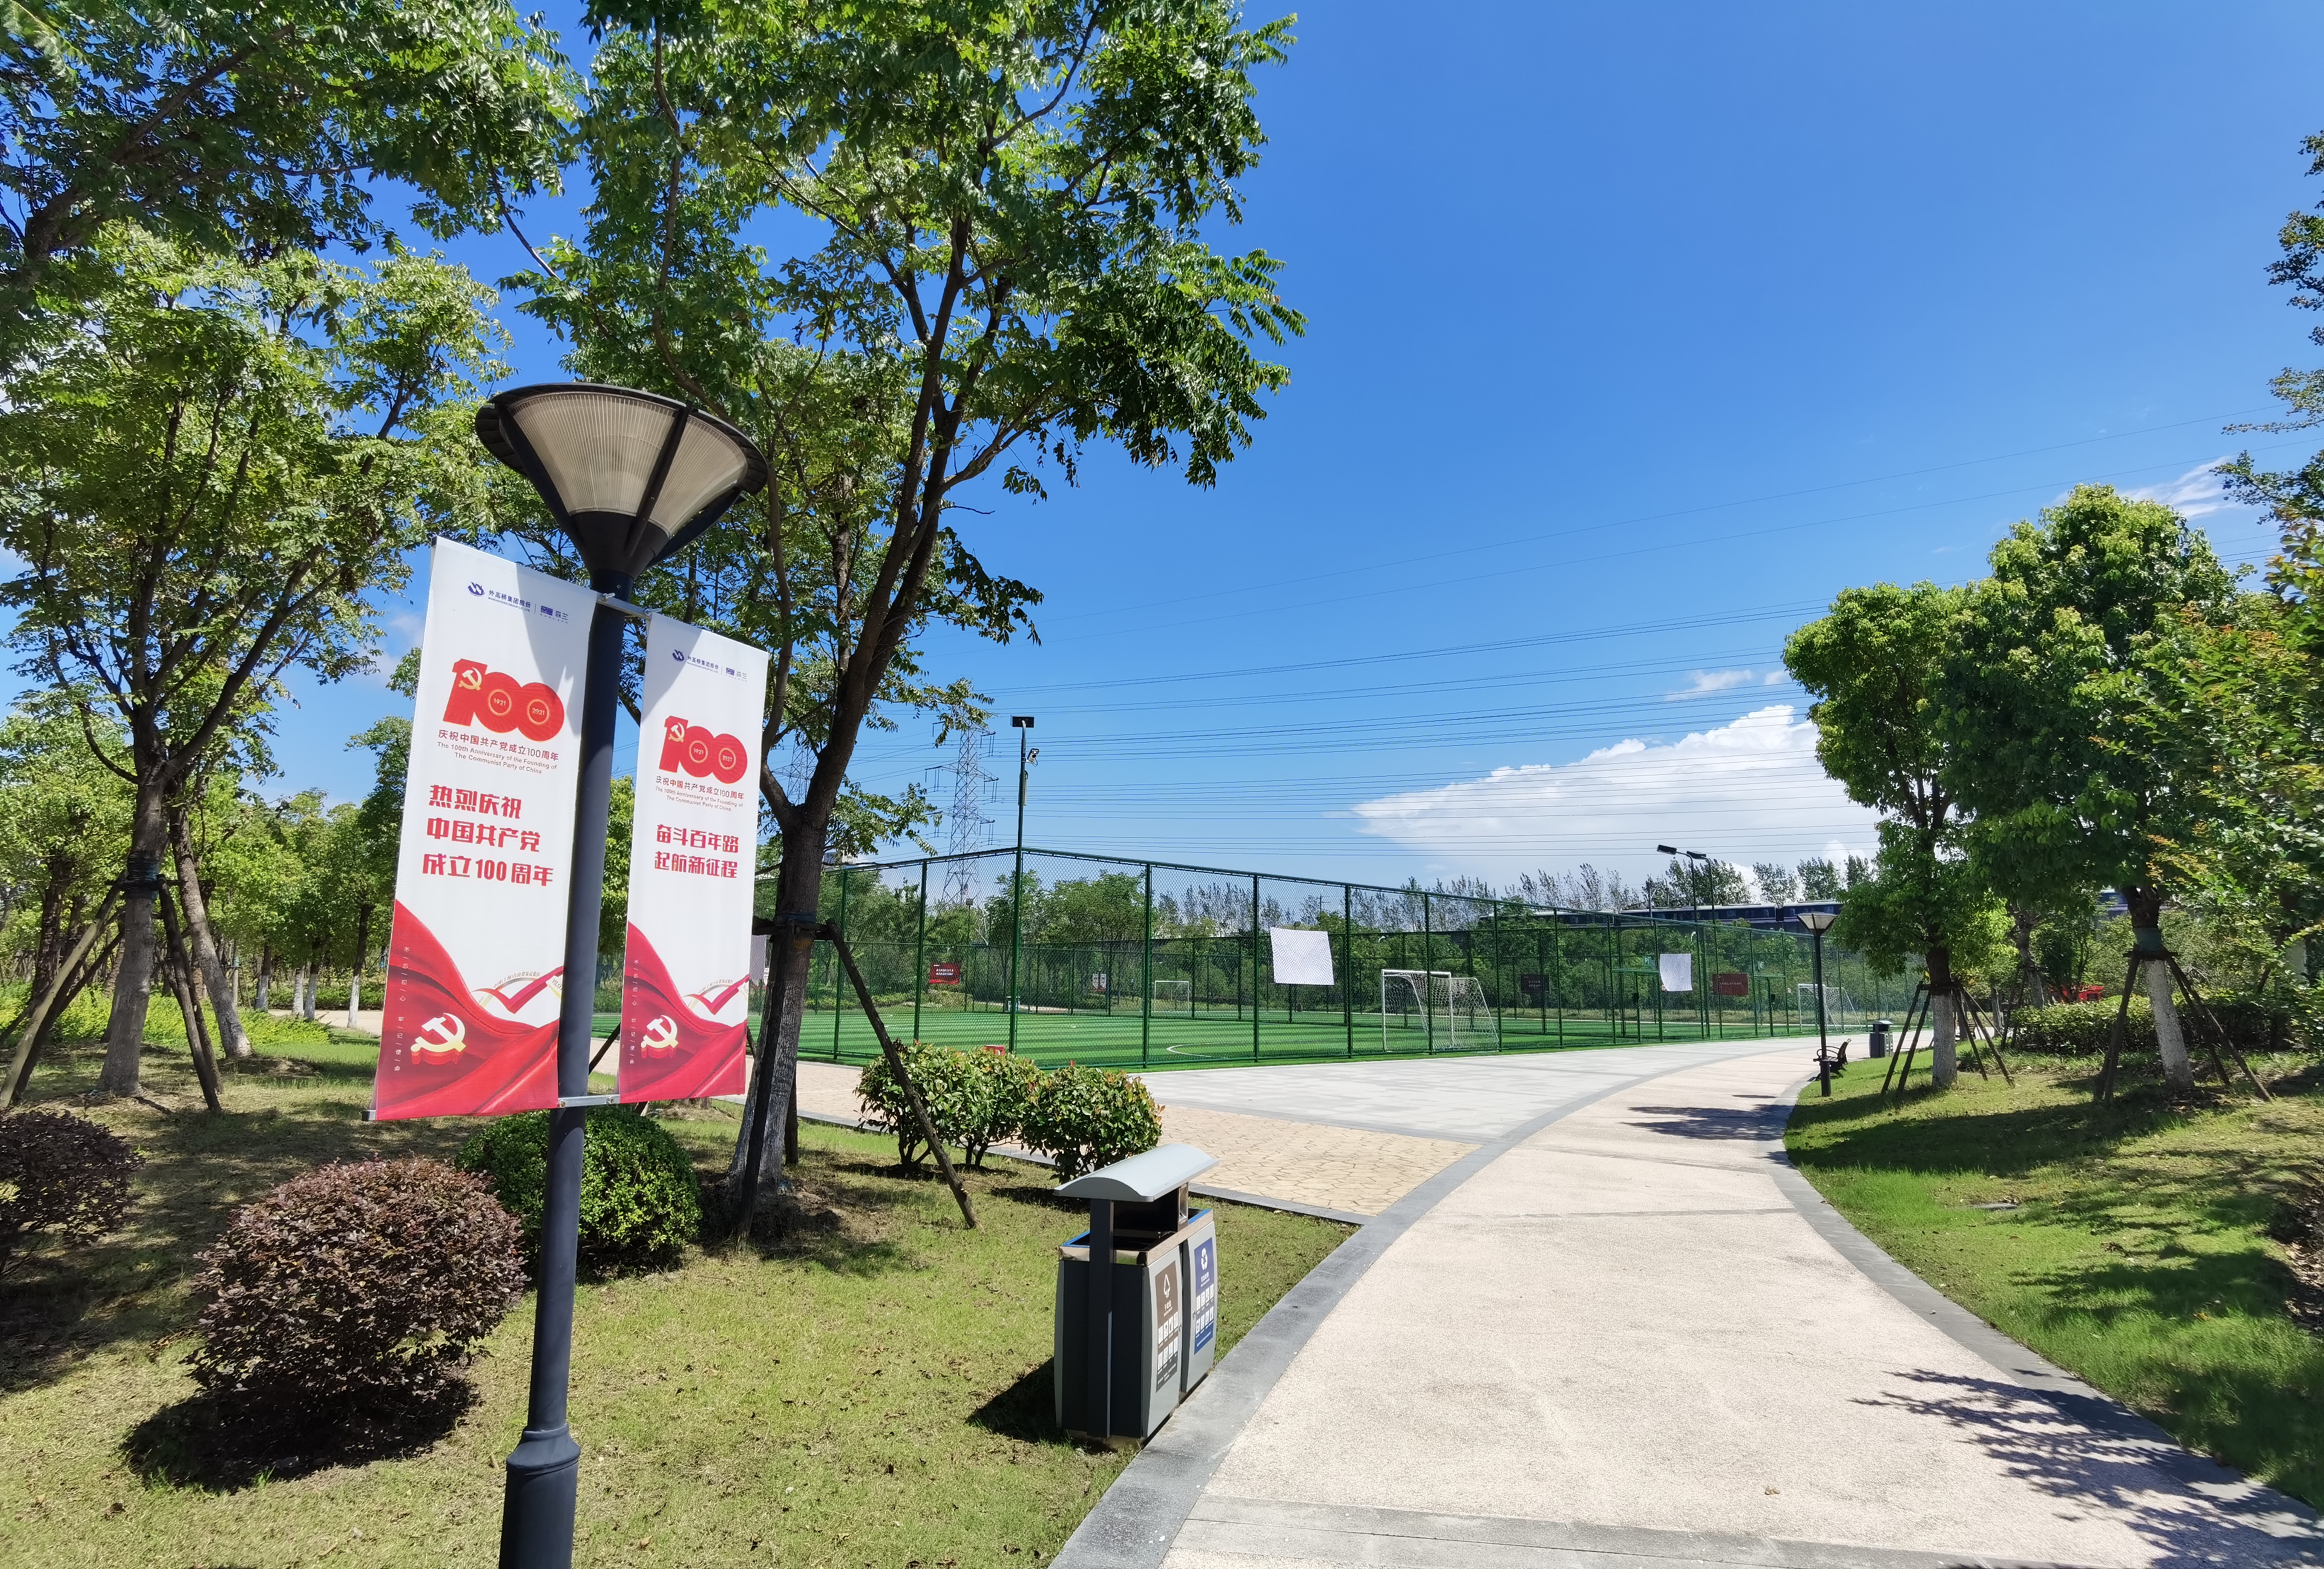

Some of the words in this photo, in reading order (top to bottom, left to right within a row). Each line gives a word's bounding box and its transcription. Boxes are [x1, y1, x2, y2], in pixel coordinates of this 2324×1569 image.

[493, 697, 506, 707] 1921
[531, 707, 545, 716] 2021
[438, 729, 559, 761] 庆祝中国共产党成立100周年
[451, 744, 468, 752] 100th
[470, 748, 505, 761] Anniversary
[524, 758, 550, 770] Founding
[468, 754, 502, 766] Communist
[503, 761, 517, 771] Party
[428, 784, 522, 819] 热烈庆祝
[427, 817, 540, 852] 中国共产党
[657, 824, 739, 854] 奋斗百年路
[422, 853, 554, 887] 成立100周年
[654, 850, 738, 878] 起航新征程
[551, 978, 563, 991] PILO
